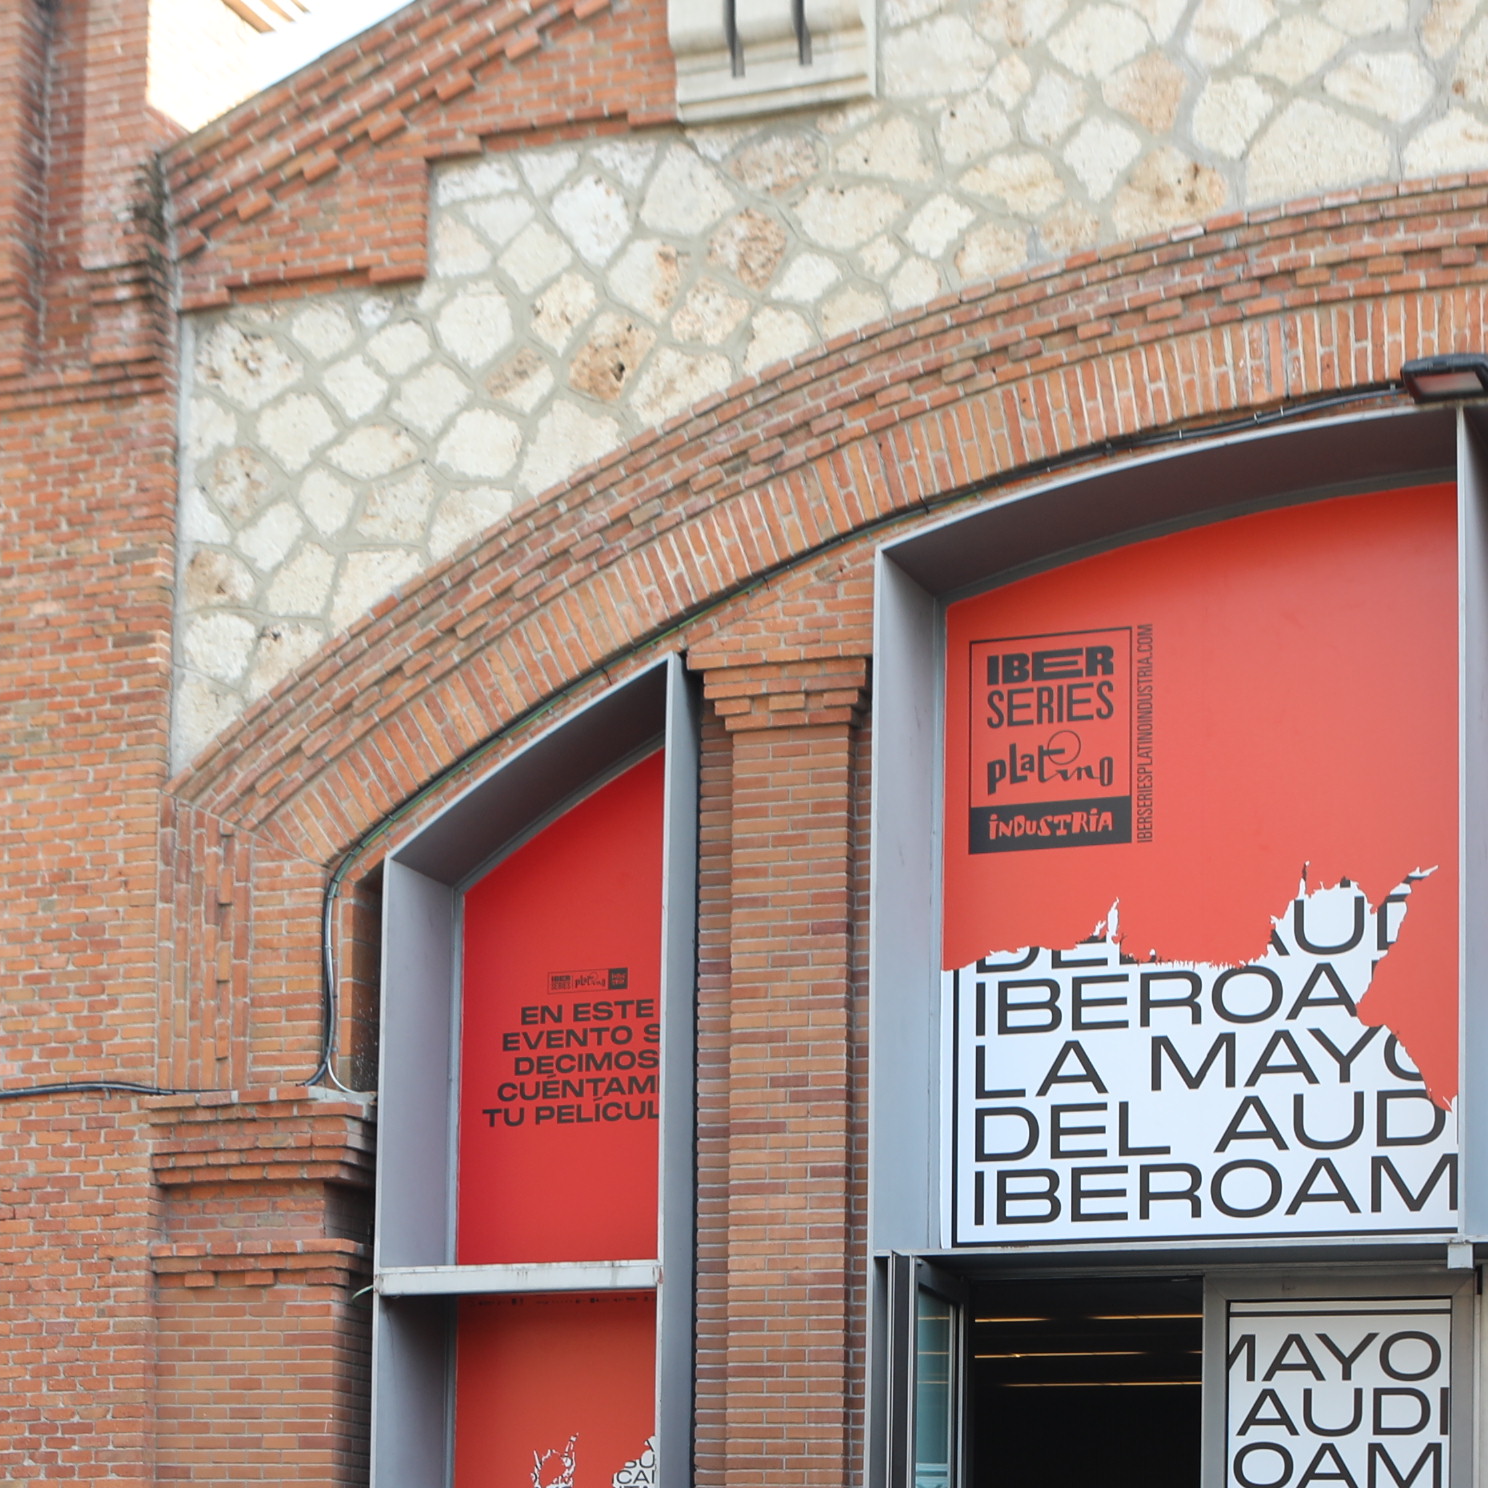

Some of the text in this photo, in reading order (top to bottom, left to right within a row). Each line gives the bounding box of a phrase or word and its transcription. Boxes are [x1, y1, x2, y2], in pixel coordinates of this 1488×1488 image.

[987, 645, 1114, 686] IBER
[987, 680, 1114, 729] SERIES
[1136, 623, 1153, 843] IBERSERIESPLATINOINDUSTRIA.COM
[520, 999, 654, 1026] EN ESTE
[502, 1025, 633, 1052] EVENTO
[514, 1049, 659, 1077] DECIMOS
[975, 1041, 1108, 1099] LA
[497, 1074, 659, 1102] CUÉNTAM
[482, 1107, 525, 1127] TU
[975, 1100, 1171, 1162] DEL
